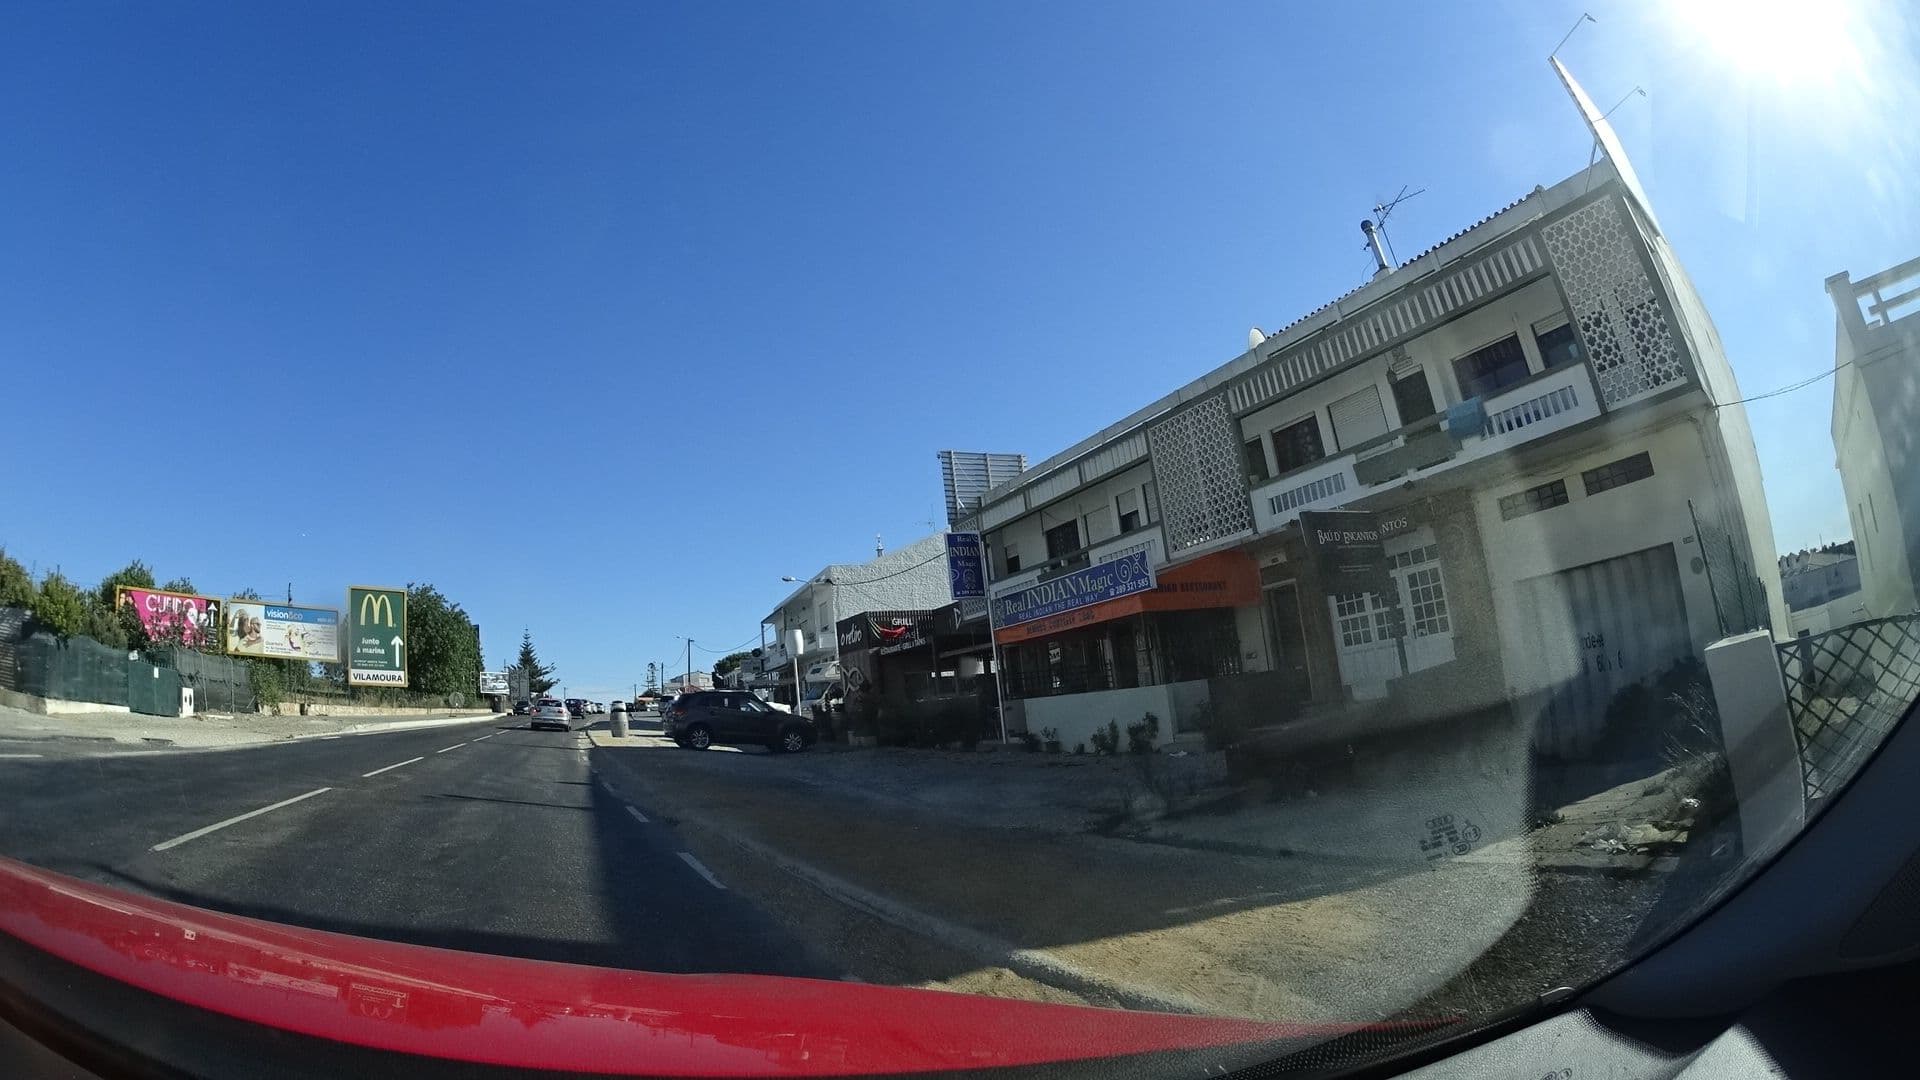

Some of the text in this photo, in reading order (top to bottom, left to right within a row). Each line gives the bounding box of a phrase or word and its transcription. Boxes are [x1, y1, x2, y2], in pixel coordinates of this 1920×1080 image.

[950, 546, 980, 557] INDIAN
[1005, 568, 1114, 616] Real INDIAN Magic
[1055, 602, 1066, 611] THE
[1067, 598, 1083, 608] REAL
[1084, 594, 1099, 605] WAY
[892, 617, 914, 626] GRILL
[361, 637, 380, 645] Junto
[362, 647, 385, 655] marina
[353, 672, 403, 683] VILAMOURA
